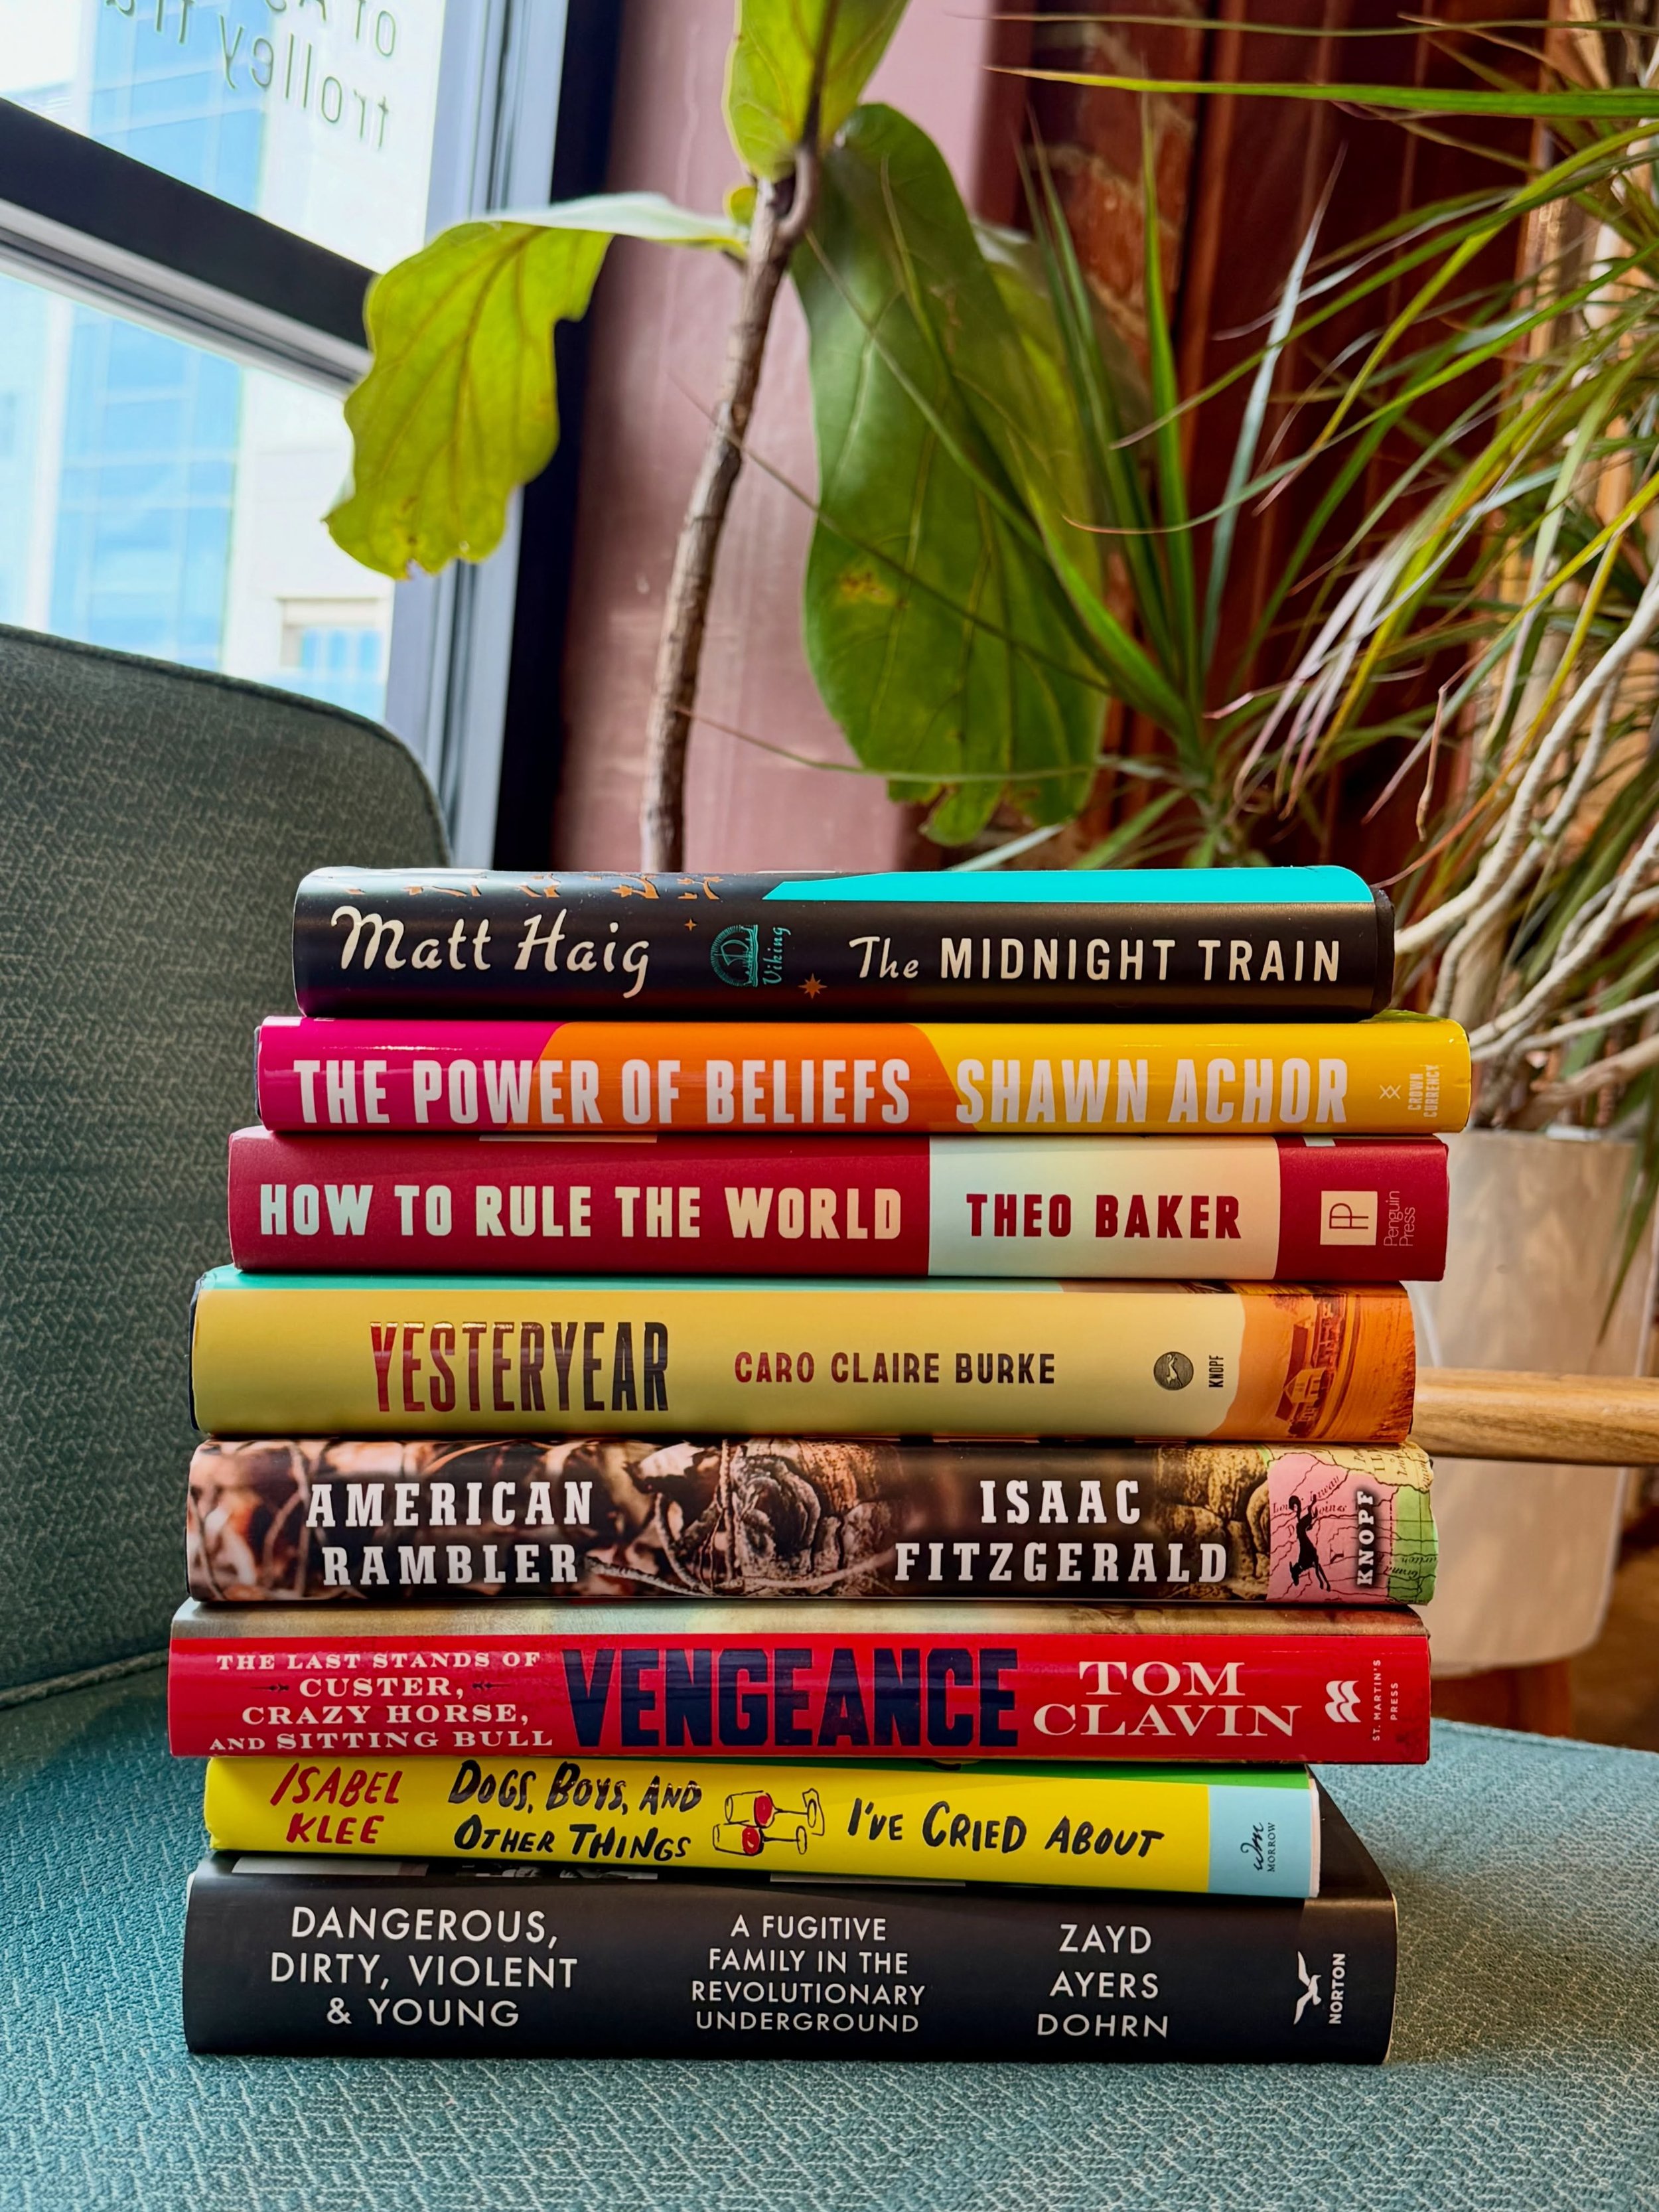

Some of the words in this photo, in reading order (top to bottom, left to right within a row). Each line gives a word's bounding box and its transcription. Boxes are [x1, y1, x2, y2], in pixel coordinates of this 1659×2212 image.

[330, 905, 492, 970] Matt
[514, 908, 650, 998] Haig
[762, 926, 791, 985] Viking
[849, 936, 919, 979] The
[941, 937, 1177, 981] MIDNIGHT
[1198, 939, 1340, 982] TRAIN
[293, 1059, 390, 1125] THE
[413, 1059, 603, 1125] POWER
[622, 1059, 680, 1125] OF
[706, 1059, 910, 1125] BELIEFS
[956, 1058, 1149, 1124] SHAWN
[1168, 1057, 1348, 1124] ACHOR
[1407, 1073, 1423, 1110] CROWN
[1423, 1065, 1439, 1118] CURRENCY
[260, 1183, 373, 1236] HOW
[394, 1184, 453, 1236] TO
[476, 1185, 591, 1238] RULE
[615, 1186, 701, 1239] THE
[725, 1187, 901, 1240] WORLD
[966, 1193, 1072, 1238] THEO
[1095, 1194, 1242, 1239] BAKER
[1384, 1191, 1400, 1246] Penguin
[1399, 1207, 1415, 1247] Press
[370, 1321, 669, 1412] YESTERYEAR
[735, 1351, 814, 1383] CARO
[830, 1352, 940, 1384] CLAIRE
[956, 1353, 1055, 1384] BURKE
[1208, 1355, 1224, 1388] KNOPF
[306, 1481, 593, 1528] AMERICAN
[980, 1480, 1140, 1524] ISAAC
[1357, 1491, 1374, 1585] KNOPF
[322, 1544, 579, 1586] RAMBLER
[895, 1542, 1227, 1584] FITZGERALD
[216, 1655, 275, 1671] THE
[287, 1653, 366, 1670] LAST
[372, 1651, 491, 1669] STANDS
[502, 1651, 541, 1668] OF
[1078, 1660, 1246, 1696] TOM
[299, 1678, 464, 1700] CUSTER,
[562, 1647, 1019, 1747] VENGEANCE
[1372, 1659, 1382, 1720] MARTIN'S
[1390, 1682, 1399, 1720] PRESS
[242, 1706, 371, 1726] CRAZY
[386, 1704, 529, 1727] HORSE,
[1033, 1703, 1303, 1737] CLAVIN
[209, 1736, 265, 1751] AND
[276, 1730, 438, 1751] SITTING
[453, 1730, 553, 1748] BULL
[270, 1762, 403, 1808] ISABEL
[285, 1814, 385, 1845] KLEE
[1267, 1822, 1276, 1872] MORROW
[291, 1906, 558, 1949] DANGEROUS,
[730, 1914, 750, 1938] A
[762, 1915, 887, 1941] FUGITIVE
[1059, 1923, 1152, 1954] ZAYD
[271, 1952, 390, 1991] DIRTY,
[408, 1954, 578, 1989] VIOLENT
[709, 1948, 806, 1972] FAMILY
[818, 1951, 847, 1974] IN
[859, 1951, 908, 1974] THE
[691, 1980, 926, 2006] REVOLUTIONARY
[1049, 1972, 1159, 1999] AYERS
[1329, 1953, 1346, 2025] NORTON
[326, 1998, 352, 2026] &
[368, 1998, 520, 2028] YOUNG
[696, 2010, 919, 2033] UNDERGROUND
[1037, 2014, 1168, 2038] DOHRN
